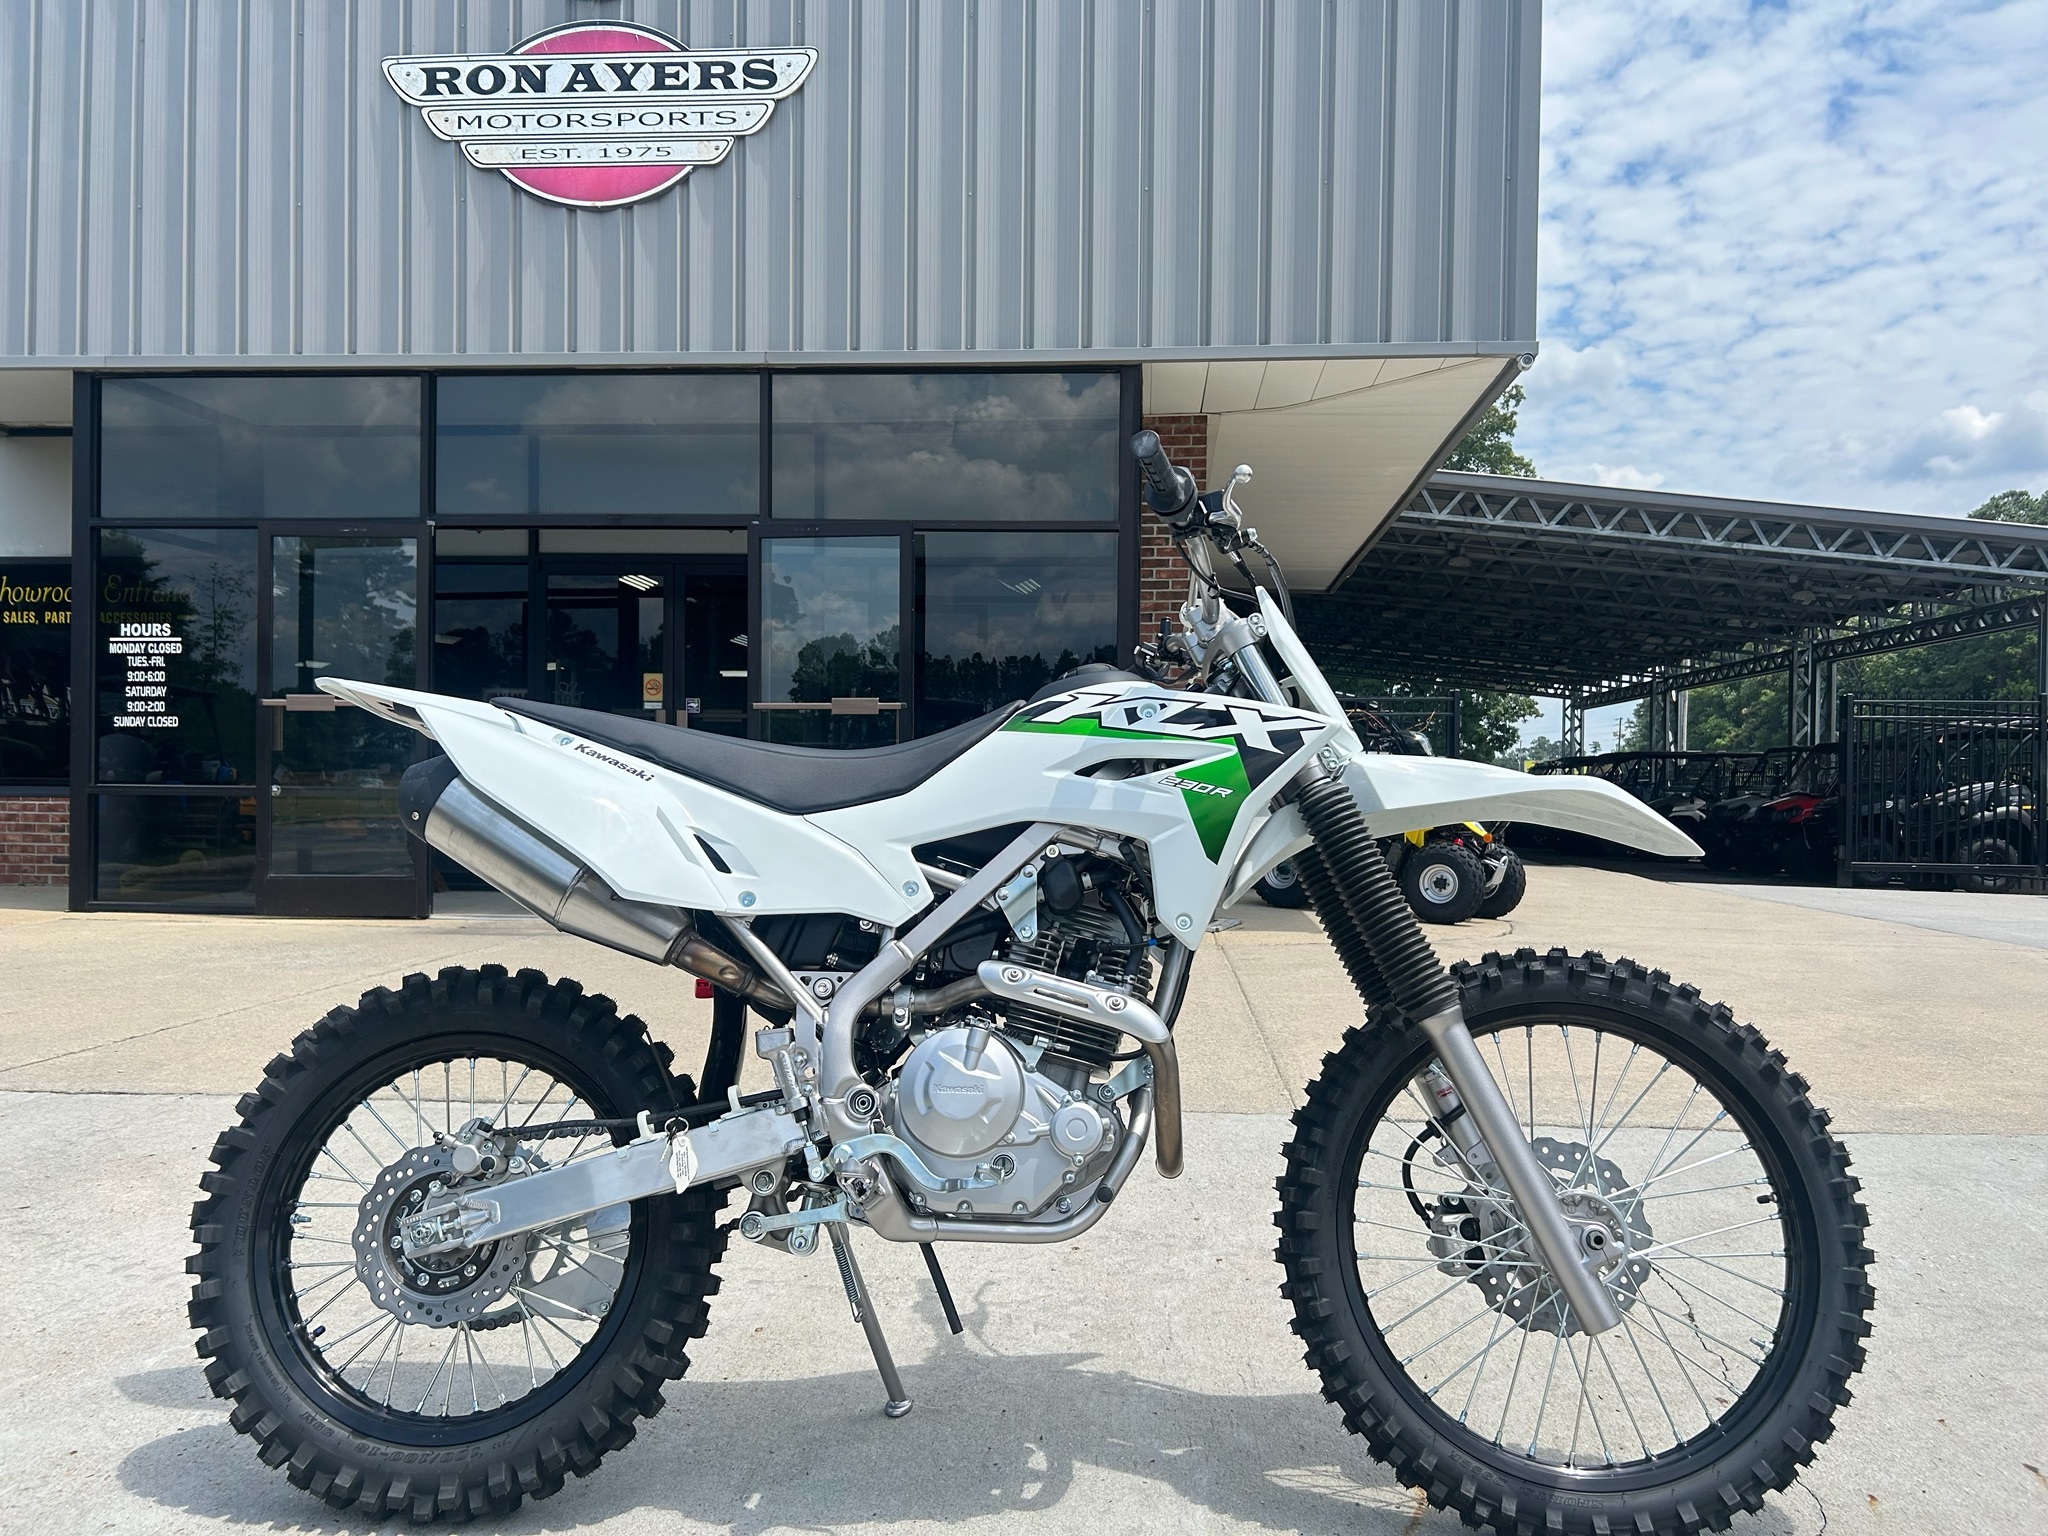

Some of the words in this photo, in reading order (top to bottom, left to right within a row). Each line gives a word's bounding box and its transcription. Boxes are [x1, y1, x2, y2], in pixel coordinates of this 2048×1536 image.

[419, 64, 552, 96] RON
[560, 58, 778, 93] AYERS
[456, 110, 737, 131] MOTORSPORTS
[521, 148, 582, 159] EST.
[600, 146, 671, 158] 1975
[3, 611, 39, 625] SALES,
[100, 612, 172, 624] ACCESSORIES
[120, 623, 172, 637] HOURS
[109, 643, 146, 654] MONDAY
[147, 643, 183, 654] CLOSED
[127, 671, 166, 682] 9:00-6:00
[125, 686, 167, 697] SATURDAY
[127, 701, 166, 712] 9:00-2:00
[113, 716, 146, 727] SUNDAY
[147, 716, 179, 727] CLOSED
[574, 743, 655, 782] Kawasaki
[1158, 775, 1235, 798] 230R
[933, 1083, 984, 1095] Kawasaki
[234, 1142, 272, 1241] DUNLOP
[354, 1442, 482, 1464] 100/100-18
